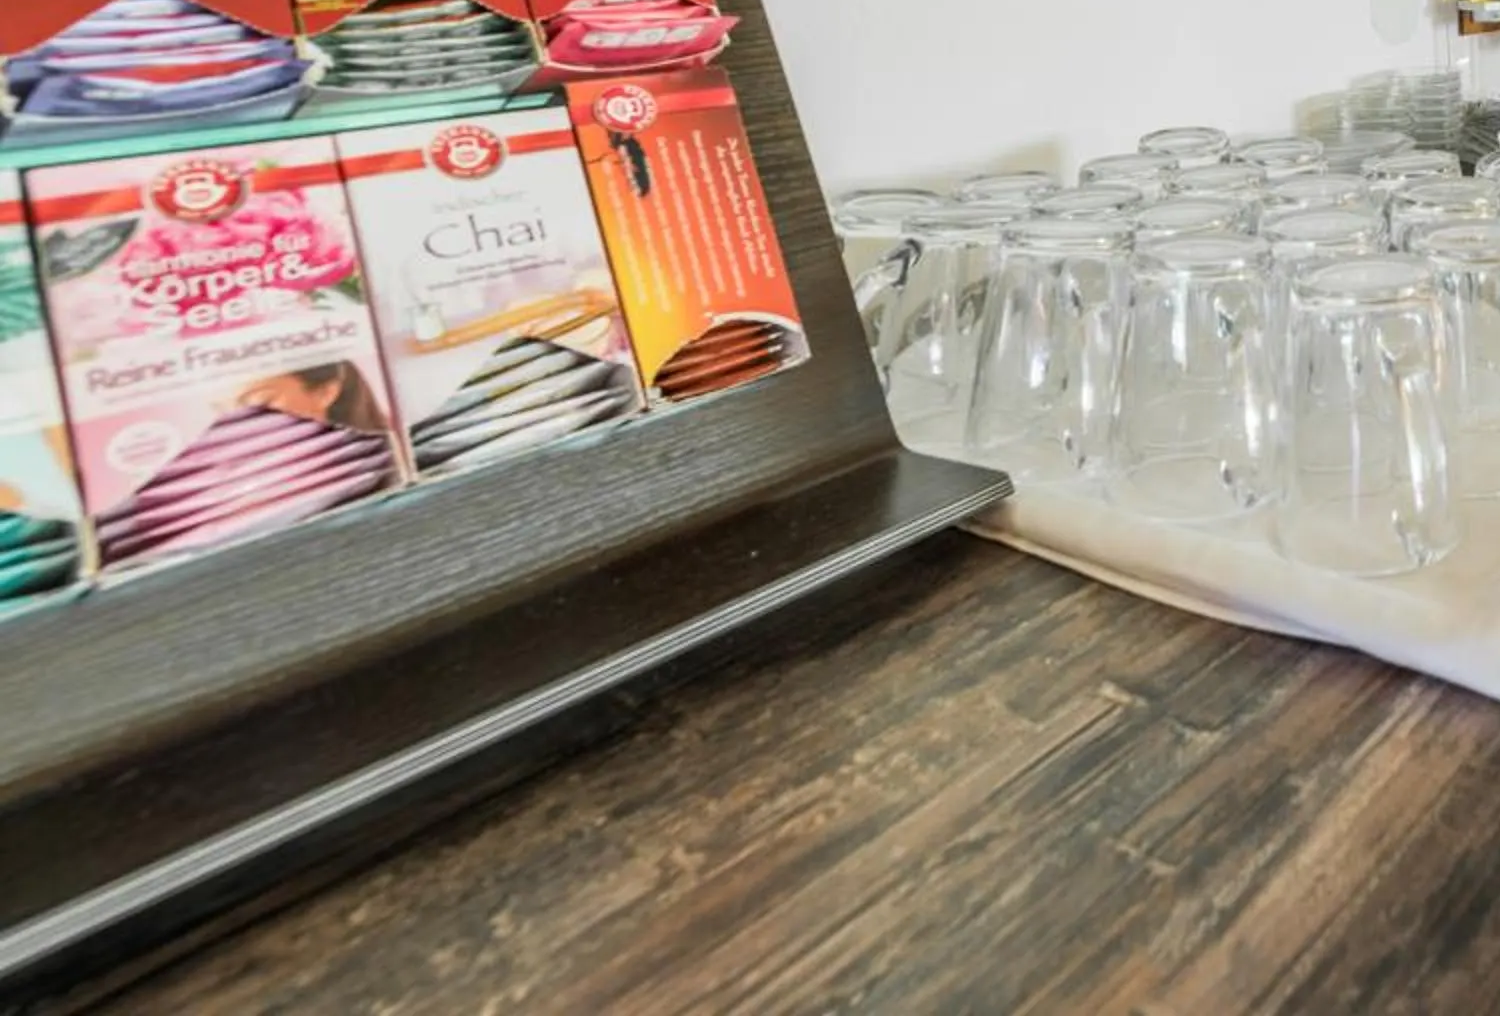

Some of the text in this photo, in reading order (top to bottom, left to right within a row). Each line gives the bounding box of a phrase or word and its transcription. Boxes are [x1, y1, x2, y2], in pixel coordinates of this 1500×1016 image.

[423, 207, 547, 259] Chai
[86, 356, 177, 392] Reine
[184, 319, 356, 371] Frauensache
